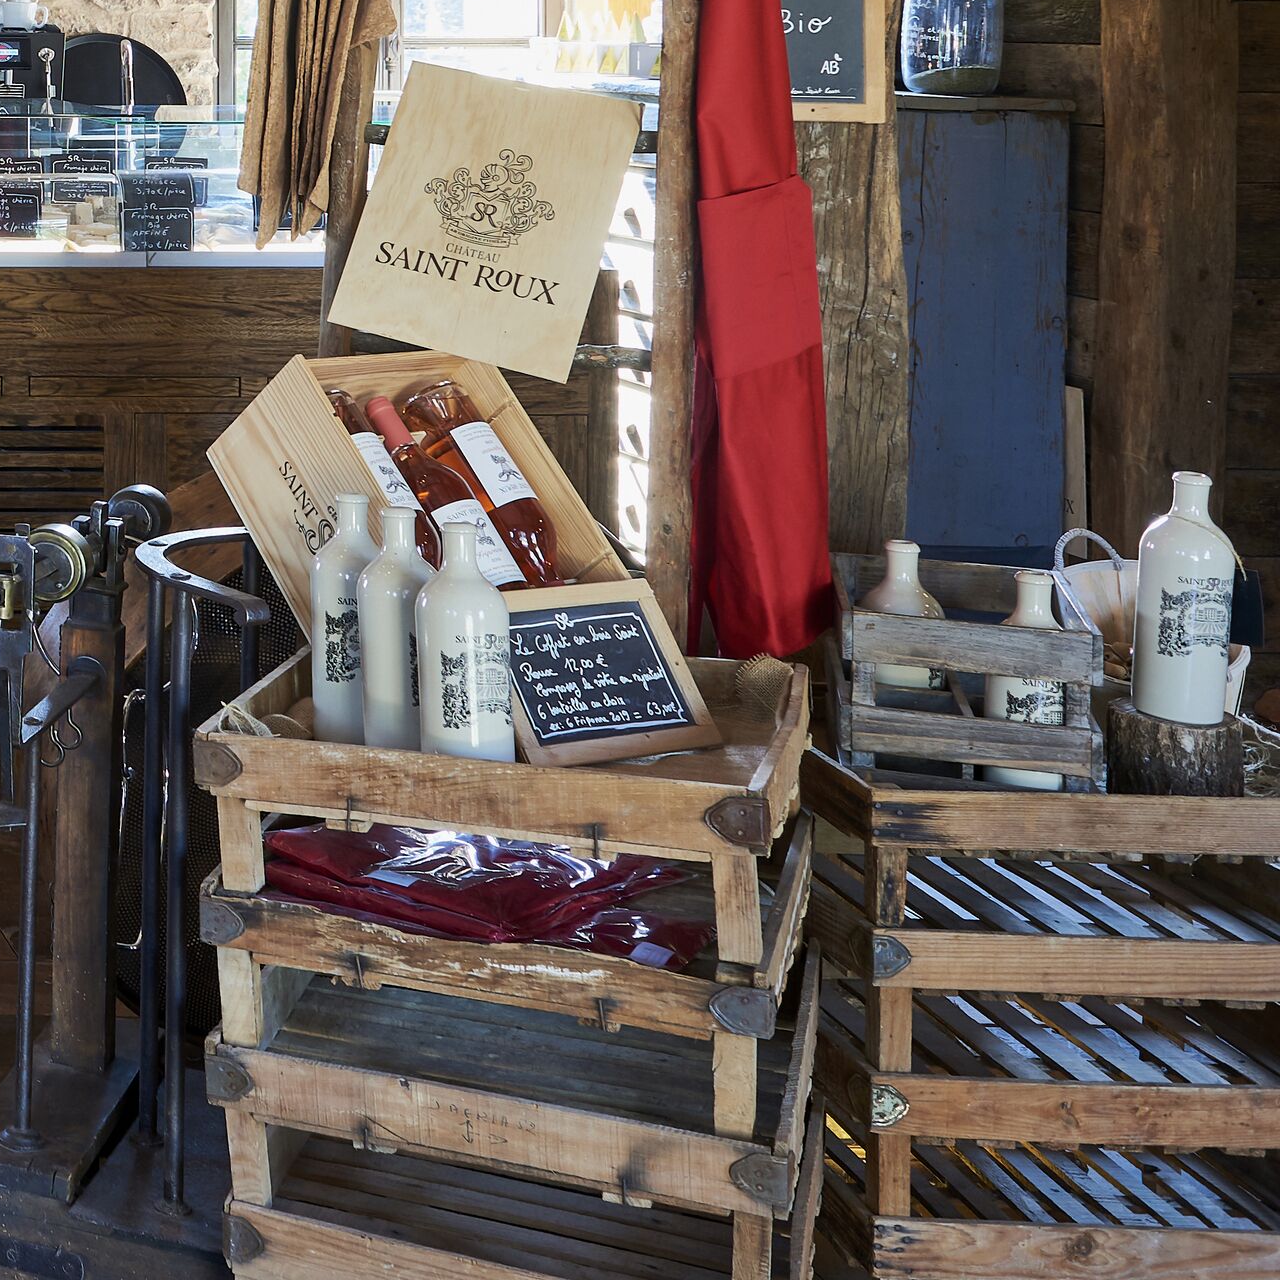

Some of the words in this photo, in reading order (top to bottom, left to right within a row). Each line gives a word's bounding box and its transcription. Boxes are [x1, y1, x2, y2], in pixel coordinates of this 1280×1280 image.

[781, 9, 832, 34] Bio
[820, 60, 840, 74] AB
[445, 242, 501, 264] CHÂTEAU
[375, 241, 467, 282] SAINT
[473, 263, 560, 305] ROUX
[511, 633, 534, 656] Le
[536, 633, 571, 659] Coffret
[590, 625, 612, 642] bois
[612, 623, 639, 641] Saint
[520, 662, 558, 682] Roux
